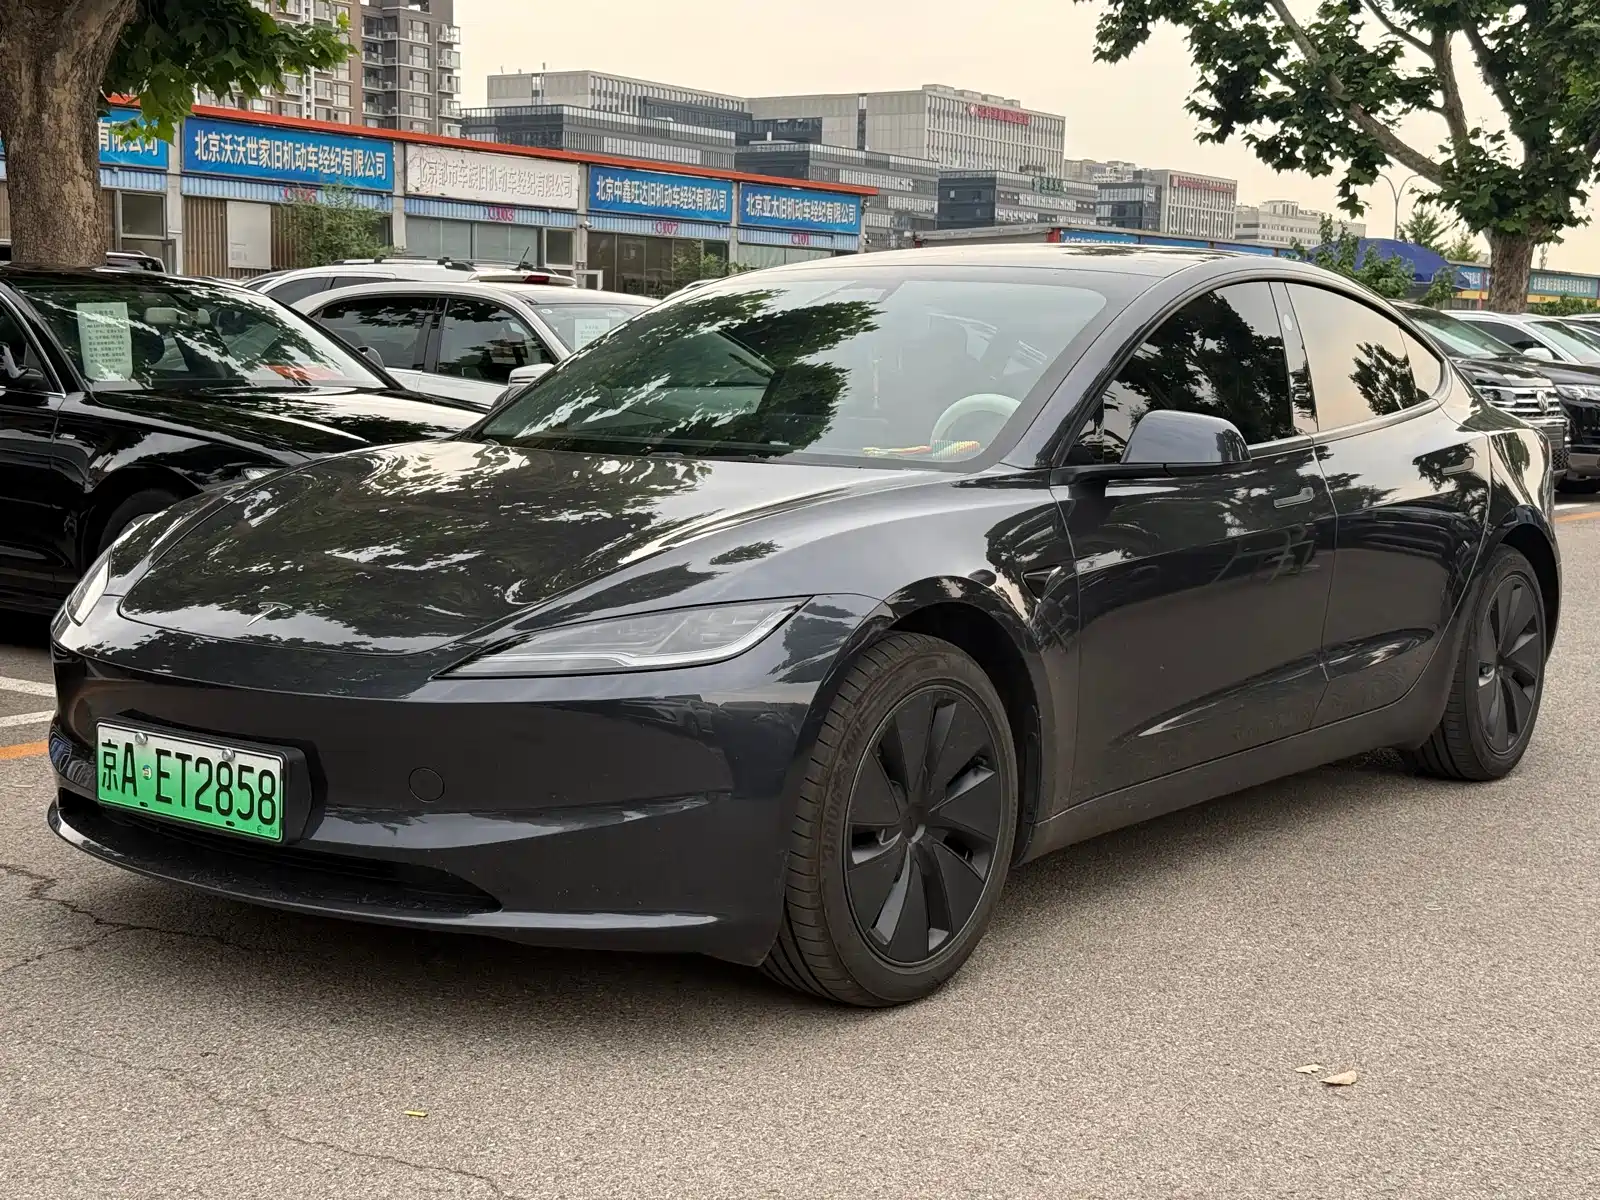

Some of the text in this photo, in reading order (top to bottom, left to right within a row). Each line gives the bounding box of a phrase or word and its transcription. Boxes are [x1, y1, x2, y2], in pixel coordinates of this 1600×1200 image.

[195, 129, 386, 180] 北京沃沃世家旧机动车经纪有限公司
[596, 174, 727, 213] 北京中鑫旺达旧机动车经纪有限公司
[746, 192, 857, 226] 北京亚太旧机动车经纪有限公司
[155, 748, 277, 825] ET2858
